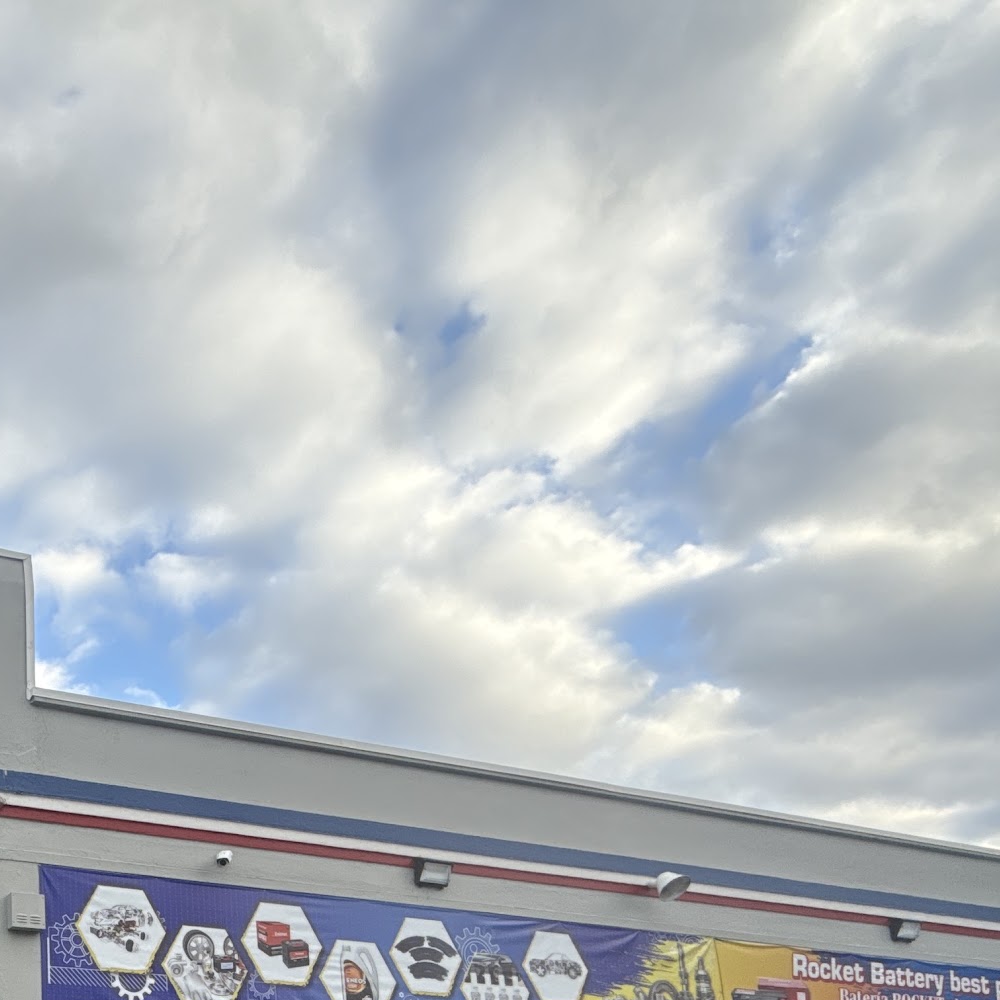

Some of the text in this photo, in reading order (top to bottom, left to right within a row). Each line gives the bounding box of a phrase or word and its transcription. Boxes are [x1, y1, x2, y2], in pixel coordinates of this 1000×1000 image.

[792, 953, 865, 984] Rocket
[870, 961, 945, 996] Battery
[949, 969, 991, 996] best
